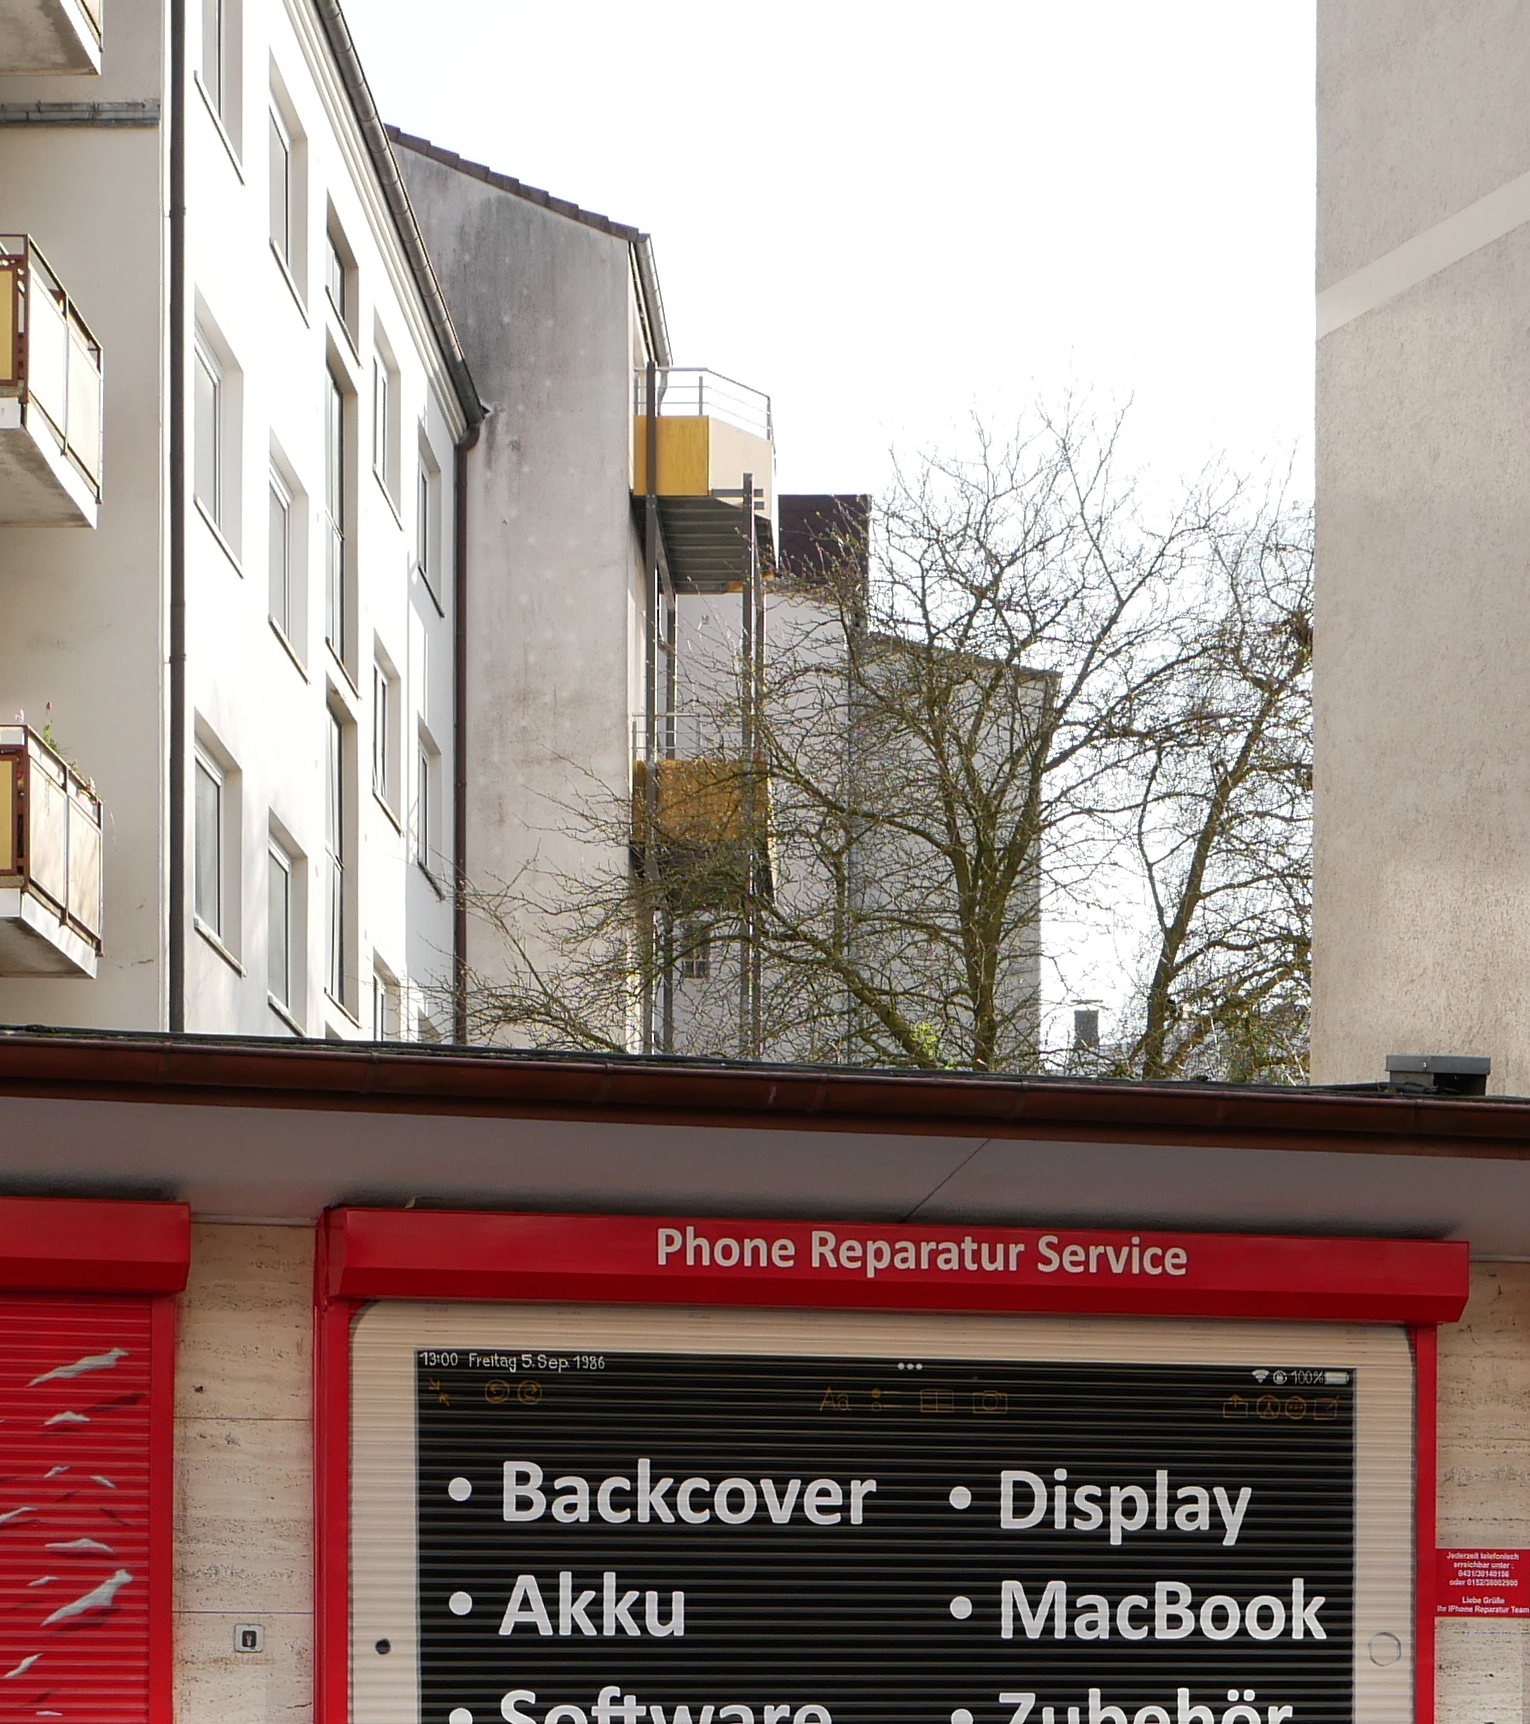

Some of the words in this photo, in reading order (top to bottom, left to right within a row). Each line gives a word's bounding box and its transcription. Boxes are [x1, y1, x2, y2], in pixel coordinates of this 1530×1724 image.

[657, 1226, 795, 1268] Phone
[811, 1231, 1026, 1278] Reparatur
[1036, 1236, 1188, 1276] Service
[420, 1352, 458, 1367] 13:00
[469, 1353, 517, 1373] Freitag
[573, 1355, 606, 1370] 1986
[1291, 1369, 1324, 1385] 100%
[502, 1458, 878, 1525] Backcover
[999, 1468, 1253, 1547] Display
[497, 1571, 686, 1638] Akku
[999, 1577, 1329, 1641] MacBook
